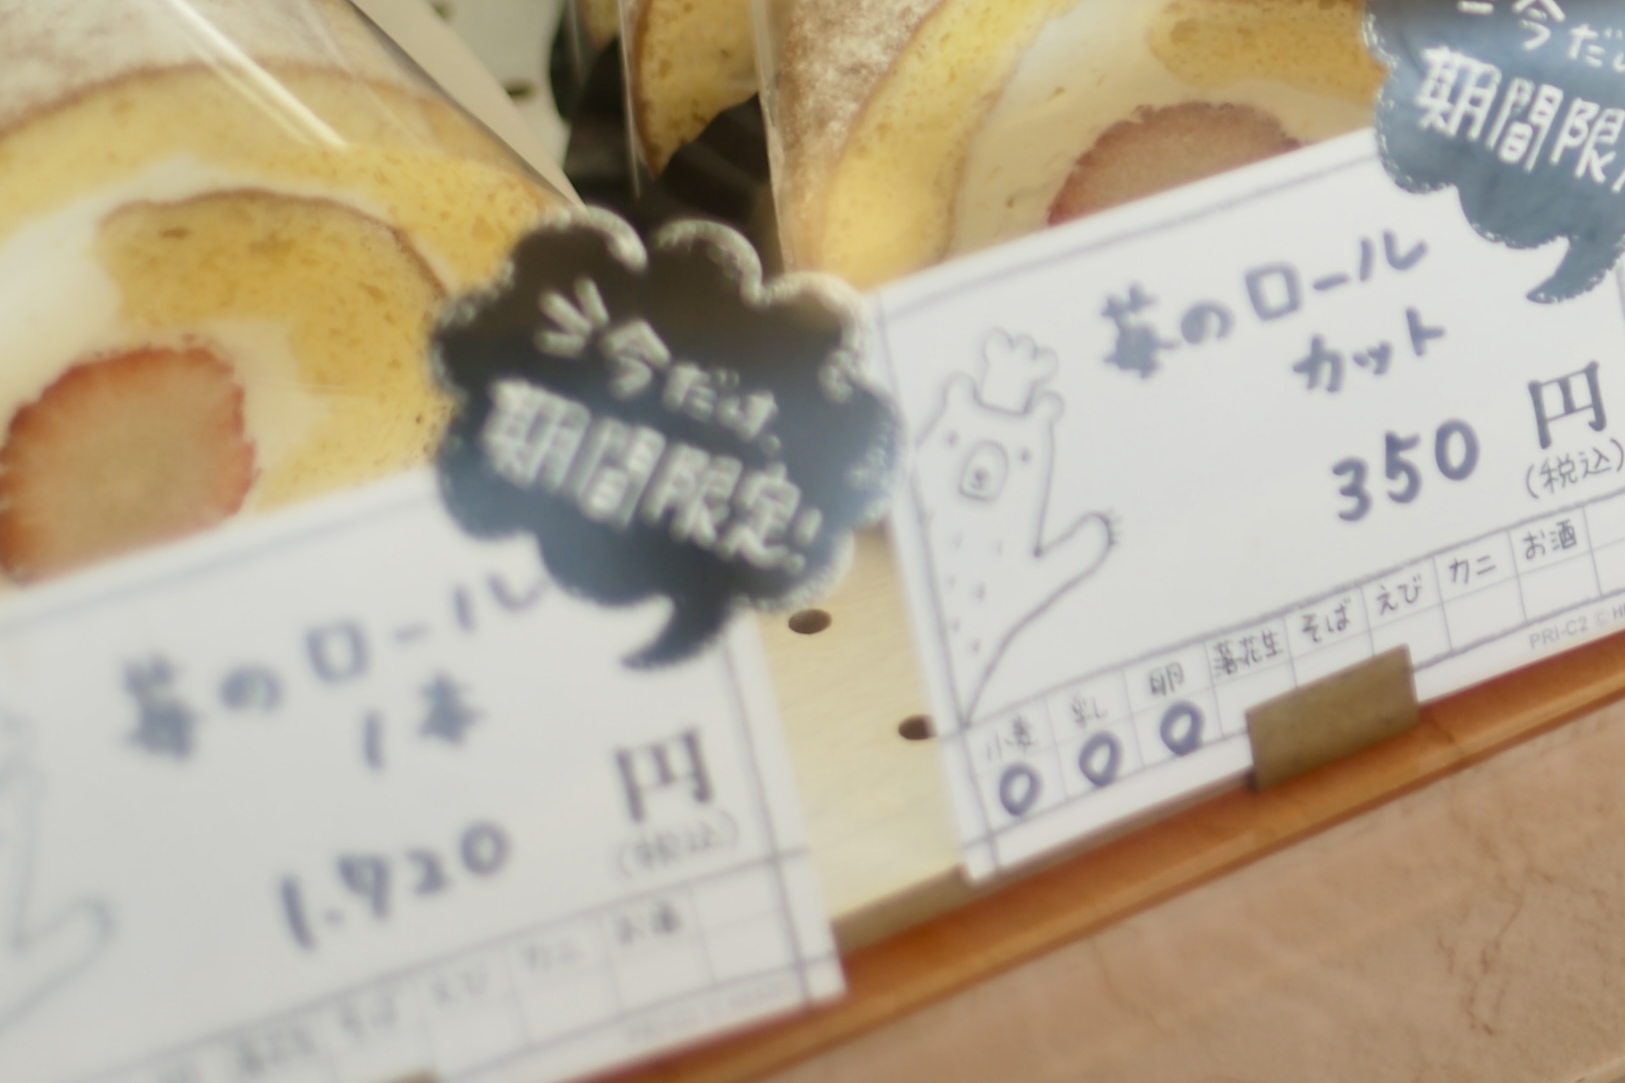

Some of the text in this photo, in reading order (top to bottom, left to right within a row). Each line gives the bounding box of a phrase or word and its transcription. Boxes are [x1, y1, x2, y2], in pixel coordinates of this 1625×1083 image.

[1291, 307, 1447, 395] カット
[1332, 360, 1609, 522] 350 円
[1525, 438, 1625, 499] (税込)
[1302, 598, 1352, 644] そば
[1376, 573, 1423, 616] えび
[1448, 554, 1497, 586] カニ
[1521, 518, 1578, 561] お酒
[1529, 616, 1589, 650] PRI-C2
[613, 728, 714, 823] 円
